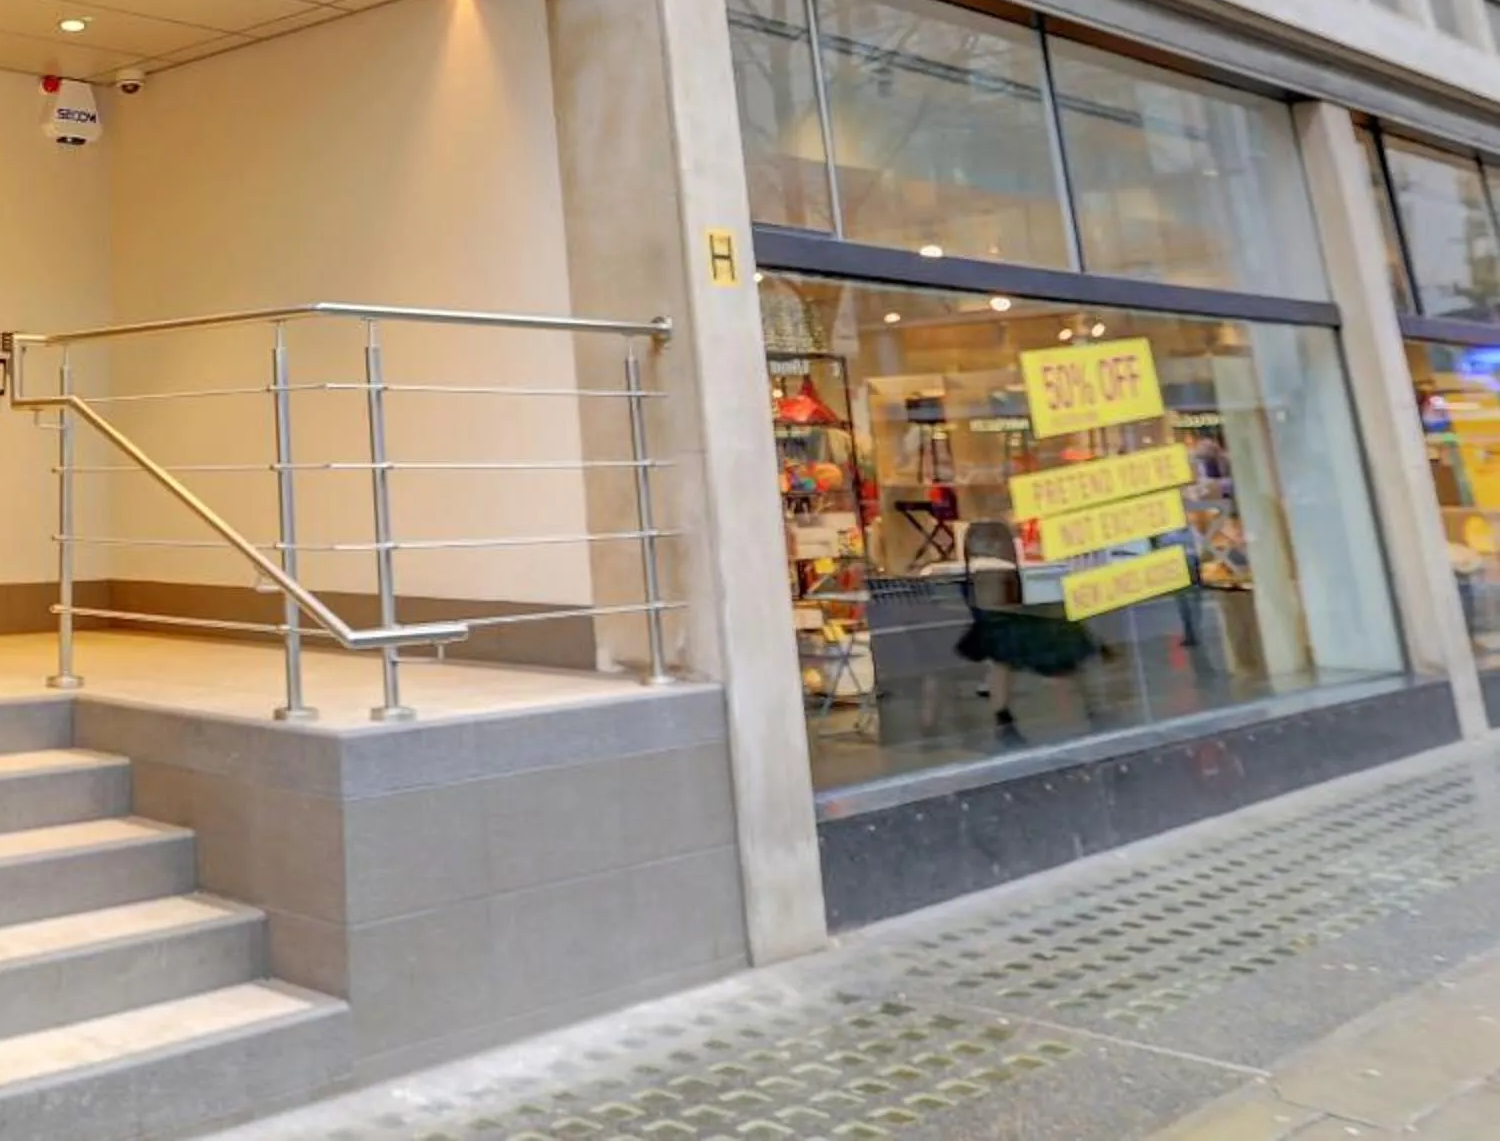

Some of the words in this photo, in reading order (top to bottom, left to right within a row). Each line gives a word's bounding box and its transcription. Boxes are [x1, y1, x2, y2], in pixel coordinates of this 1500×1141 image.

[57, 108, 97, 124] SECOM
[709, 234, 735, 280] H
[1040, 361, 1097, 410] 50%
[1098, 354, 1141, 402] OFF
[1032, 467, 1114, 507] PRETEND
[1059, 517, 1095, 547] NOT
